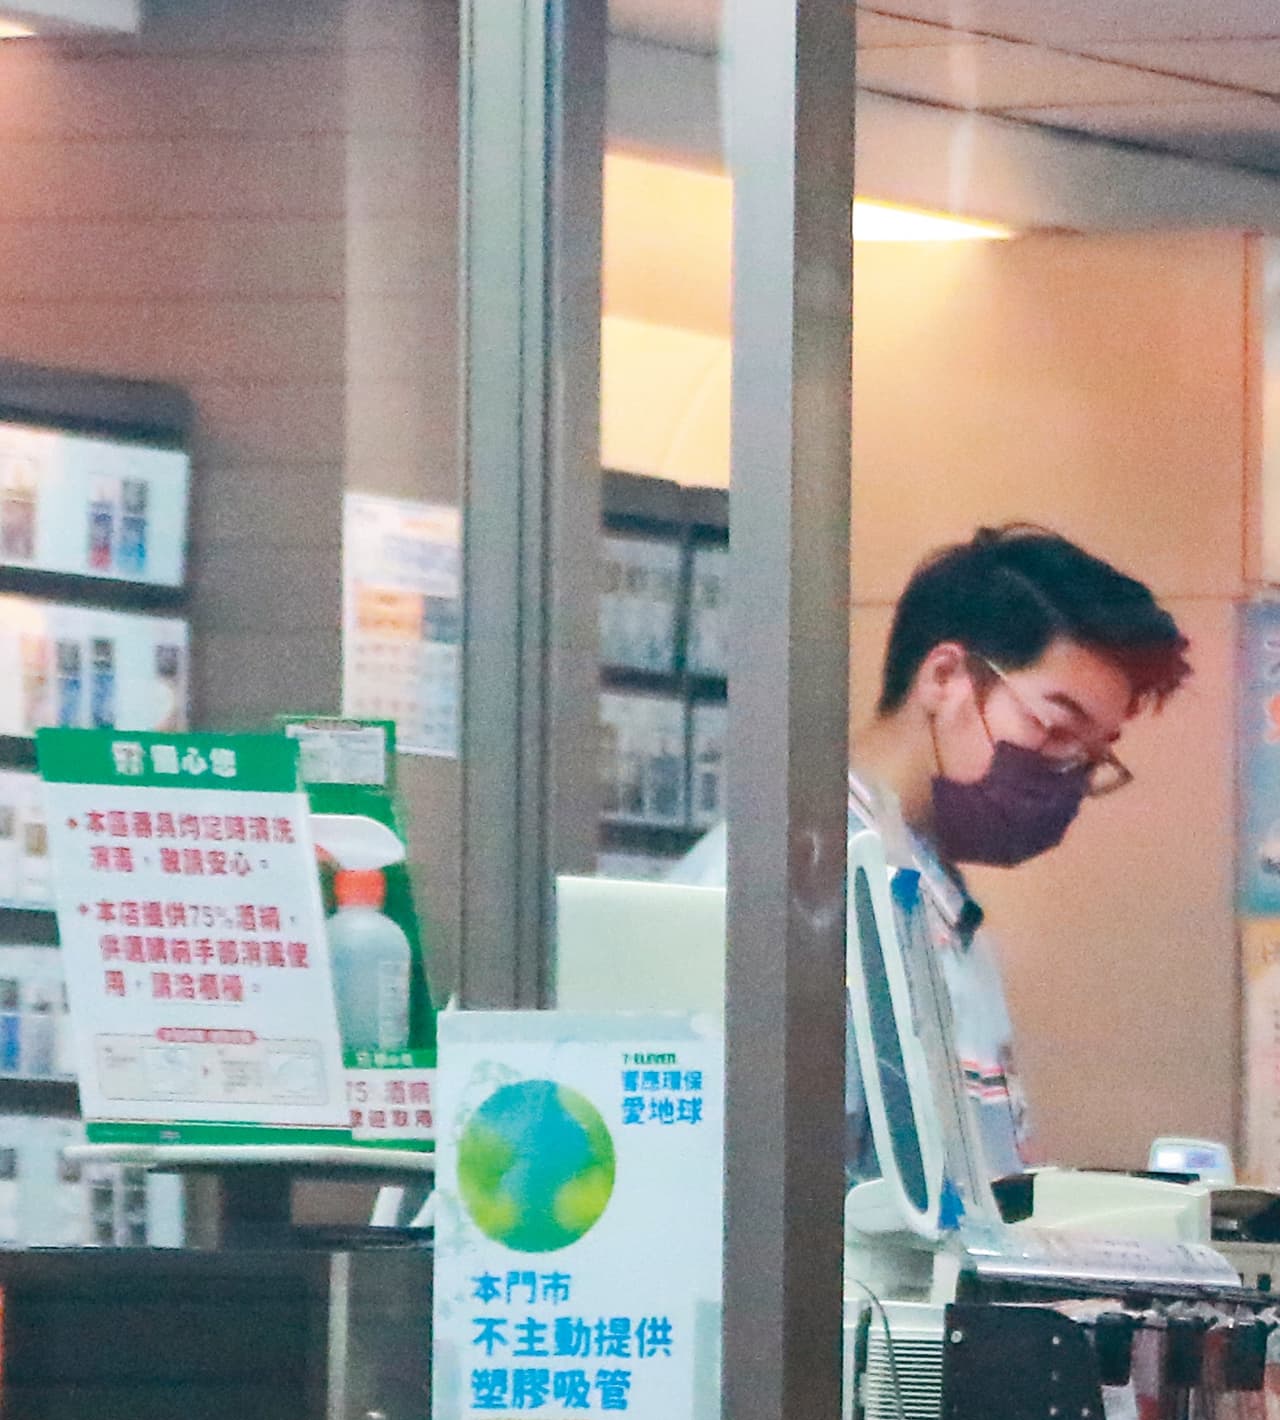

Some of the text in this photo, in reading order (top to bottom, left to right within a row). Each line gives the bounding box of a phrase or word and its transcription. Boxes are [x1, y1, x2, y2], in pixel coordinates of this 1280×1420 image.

[622, 1096, 702, 1125] 愛地球
[473, 1271, 571, 1304] 本門市
[472, 1317, 673, 1358] 不主動提供
[471, 1368, 632, 1410] 塑膠吸管
